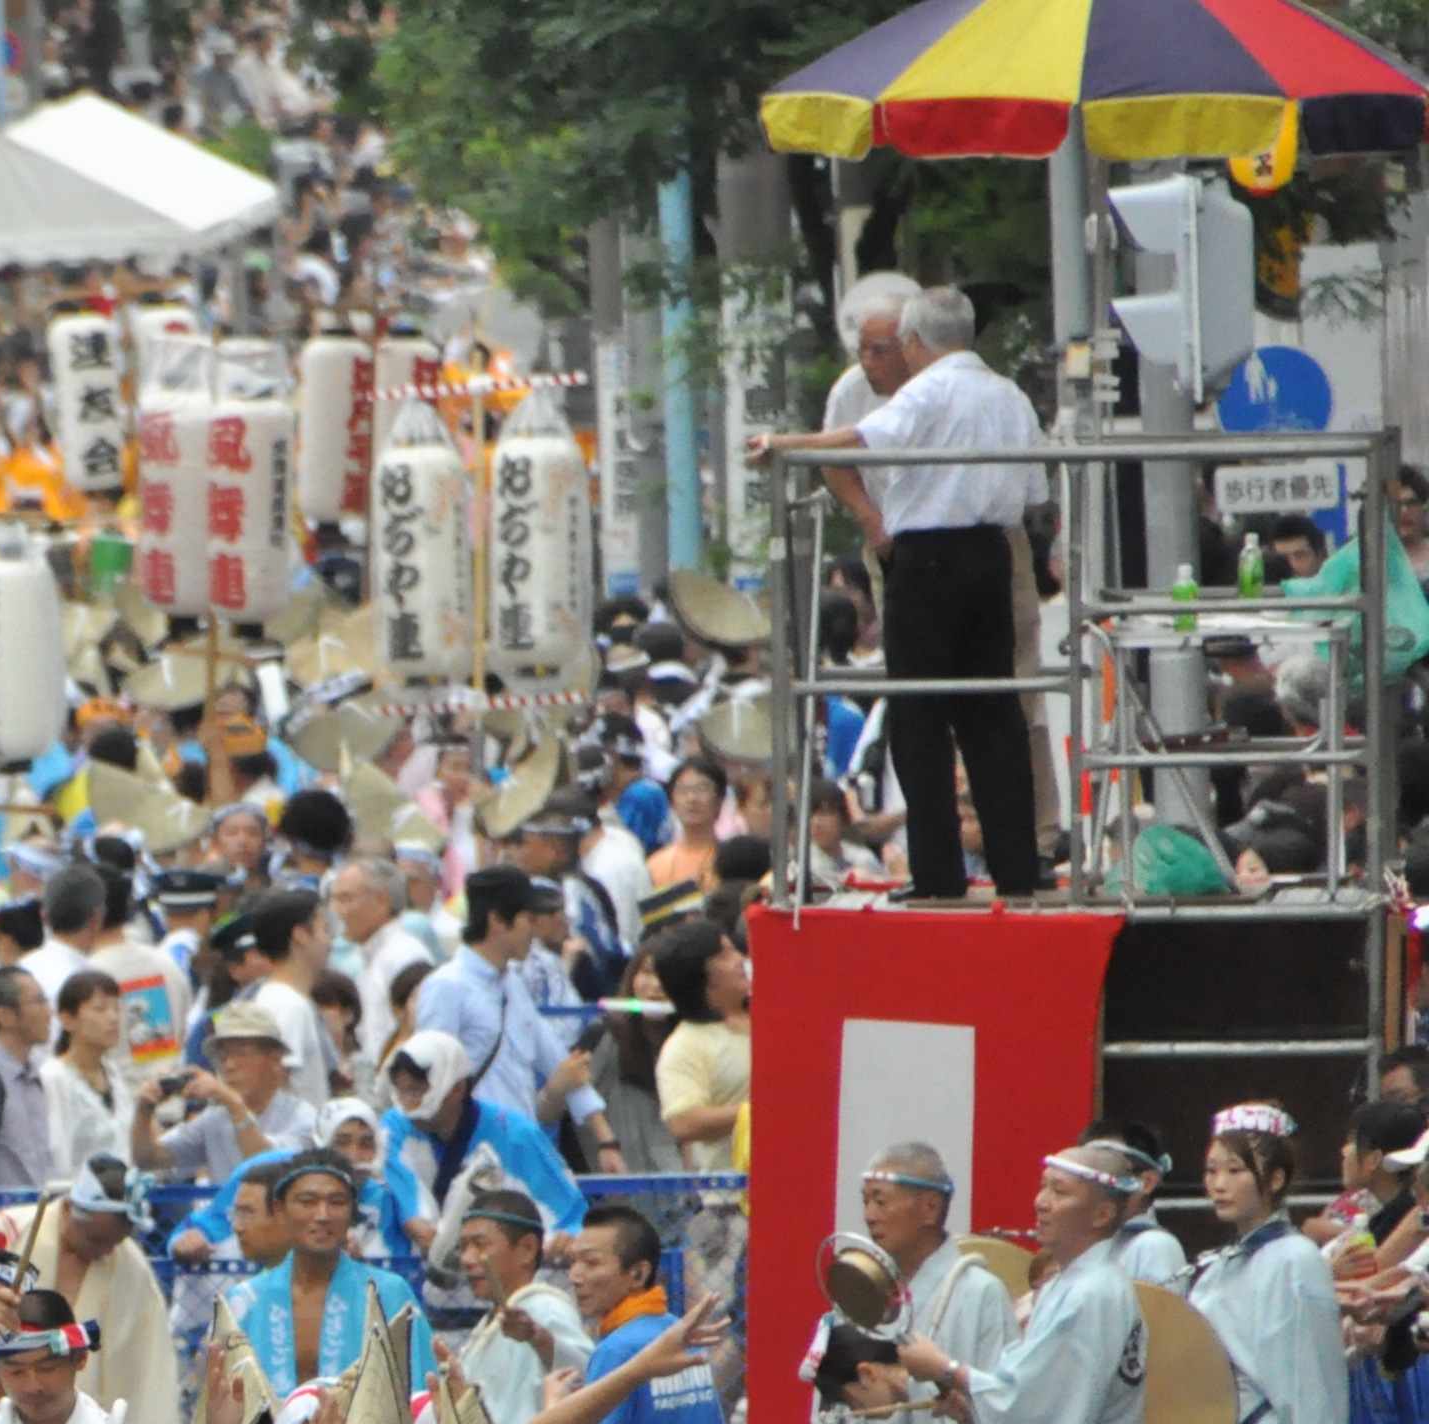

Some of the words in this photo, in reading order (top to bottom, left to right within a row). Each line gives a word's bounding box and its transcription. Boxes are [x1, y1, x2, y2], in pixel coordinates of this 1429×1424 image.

[1225, 475, 1334, 502] 歩行者優先
